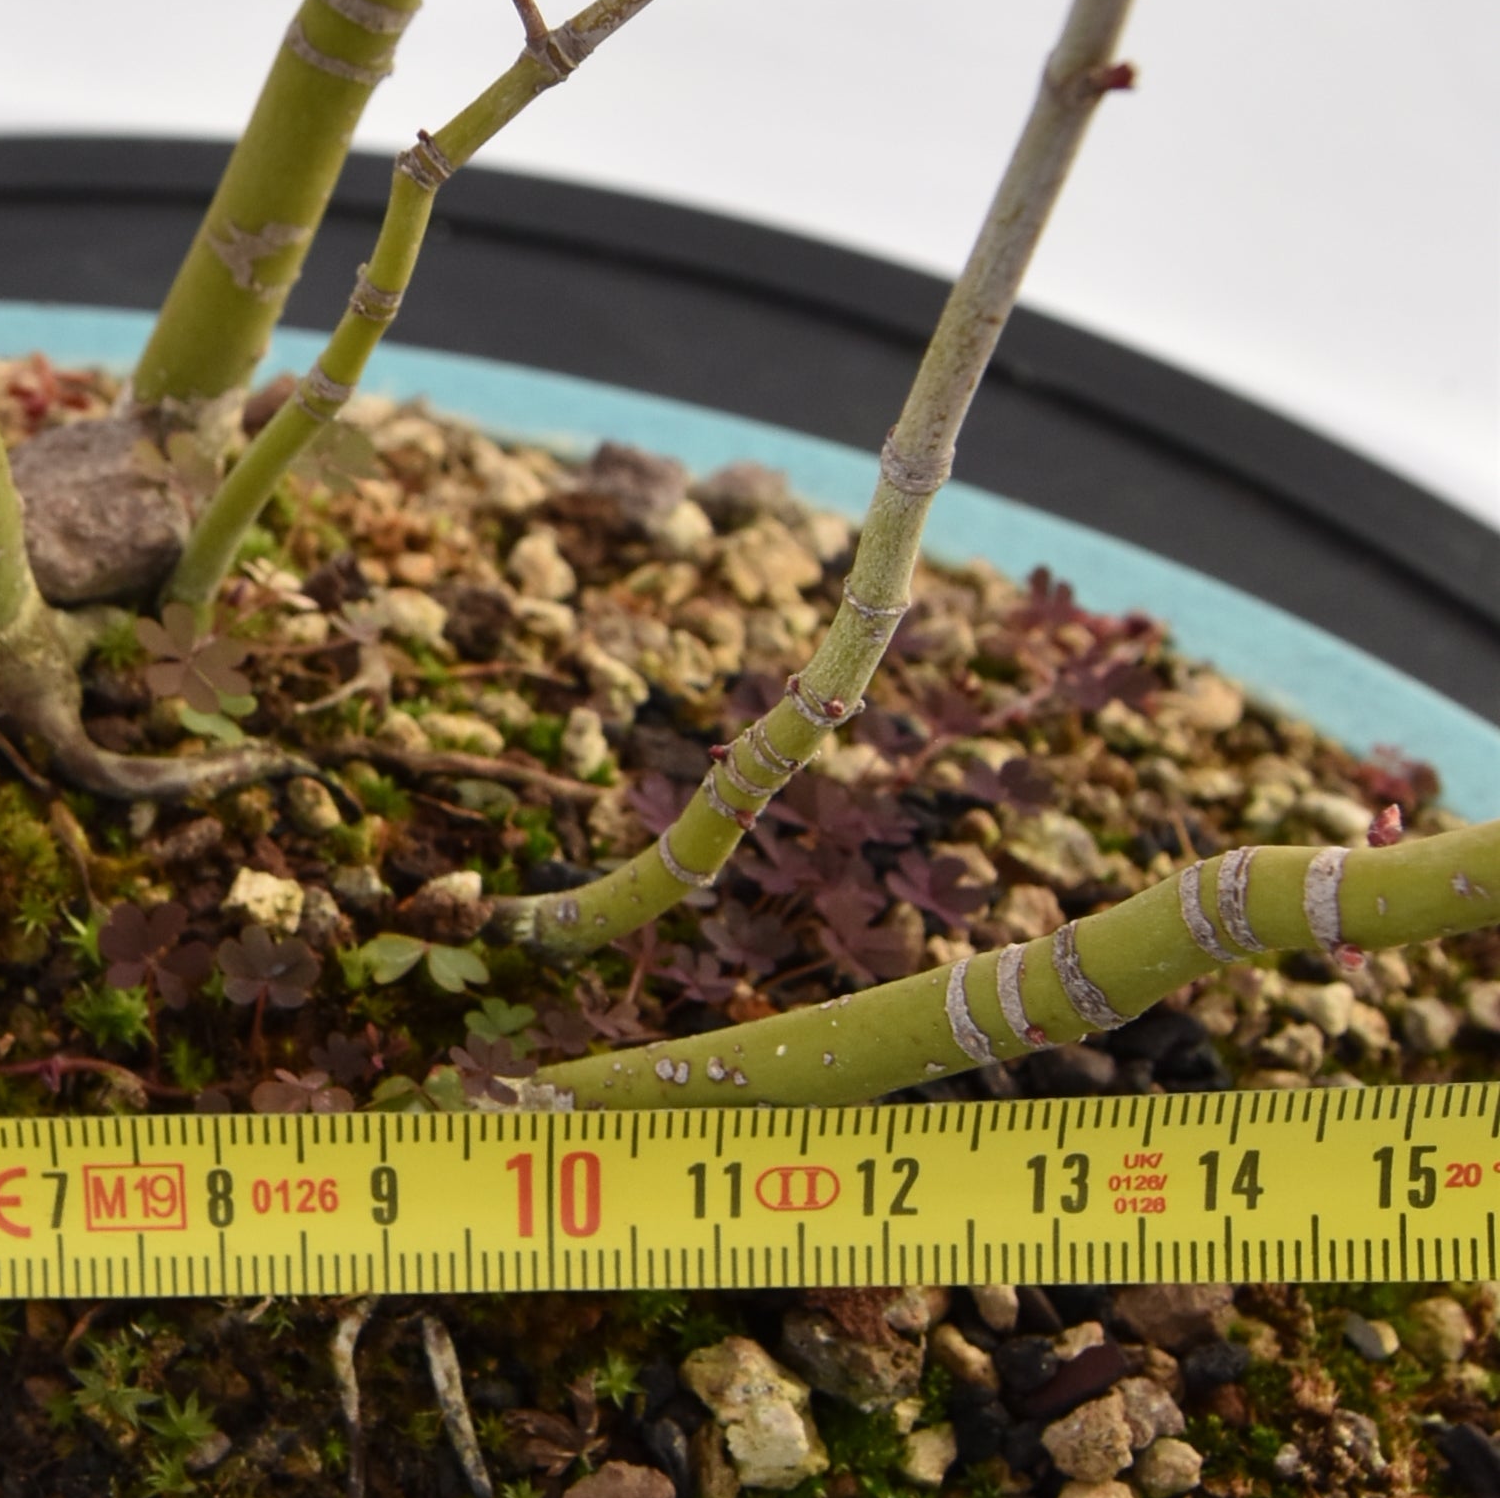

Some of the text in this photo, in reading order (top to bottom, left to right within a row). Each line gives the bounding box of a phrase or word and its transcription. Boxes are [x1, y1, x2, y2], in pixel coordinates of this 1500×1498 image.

[685, 1161, 743, 1220] 11
[854, 1156, 922, 1218] 12
[1025, 1152, 1092, 1216] 13
[1122, 1151, 1165, 1171] UK/
[1198, 1148, 1265, 1213] 14
[1371, 1144, 1439, 1211] 15
[1443, 1162, 1483, 1190] 20
[40, 1171, 70, 1230] 7
[205, 1169, 236, 1228] 8
[250, 1177, 341, 1216] 0126
[369, 1165, 400, 1226] 9
[504, 1150, 602, 1239] 10
[1112, 1195, 1168, 1215] 0128
